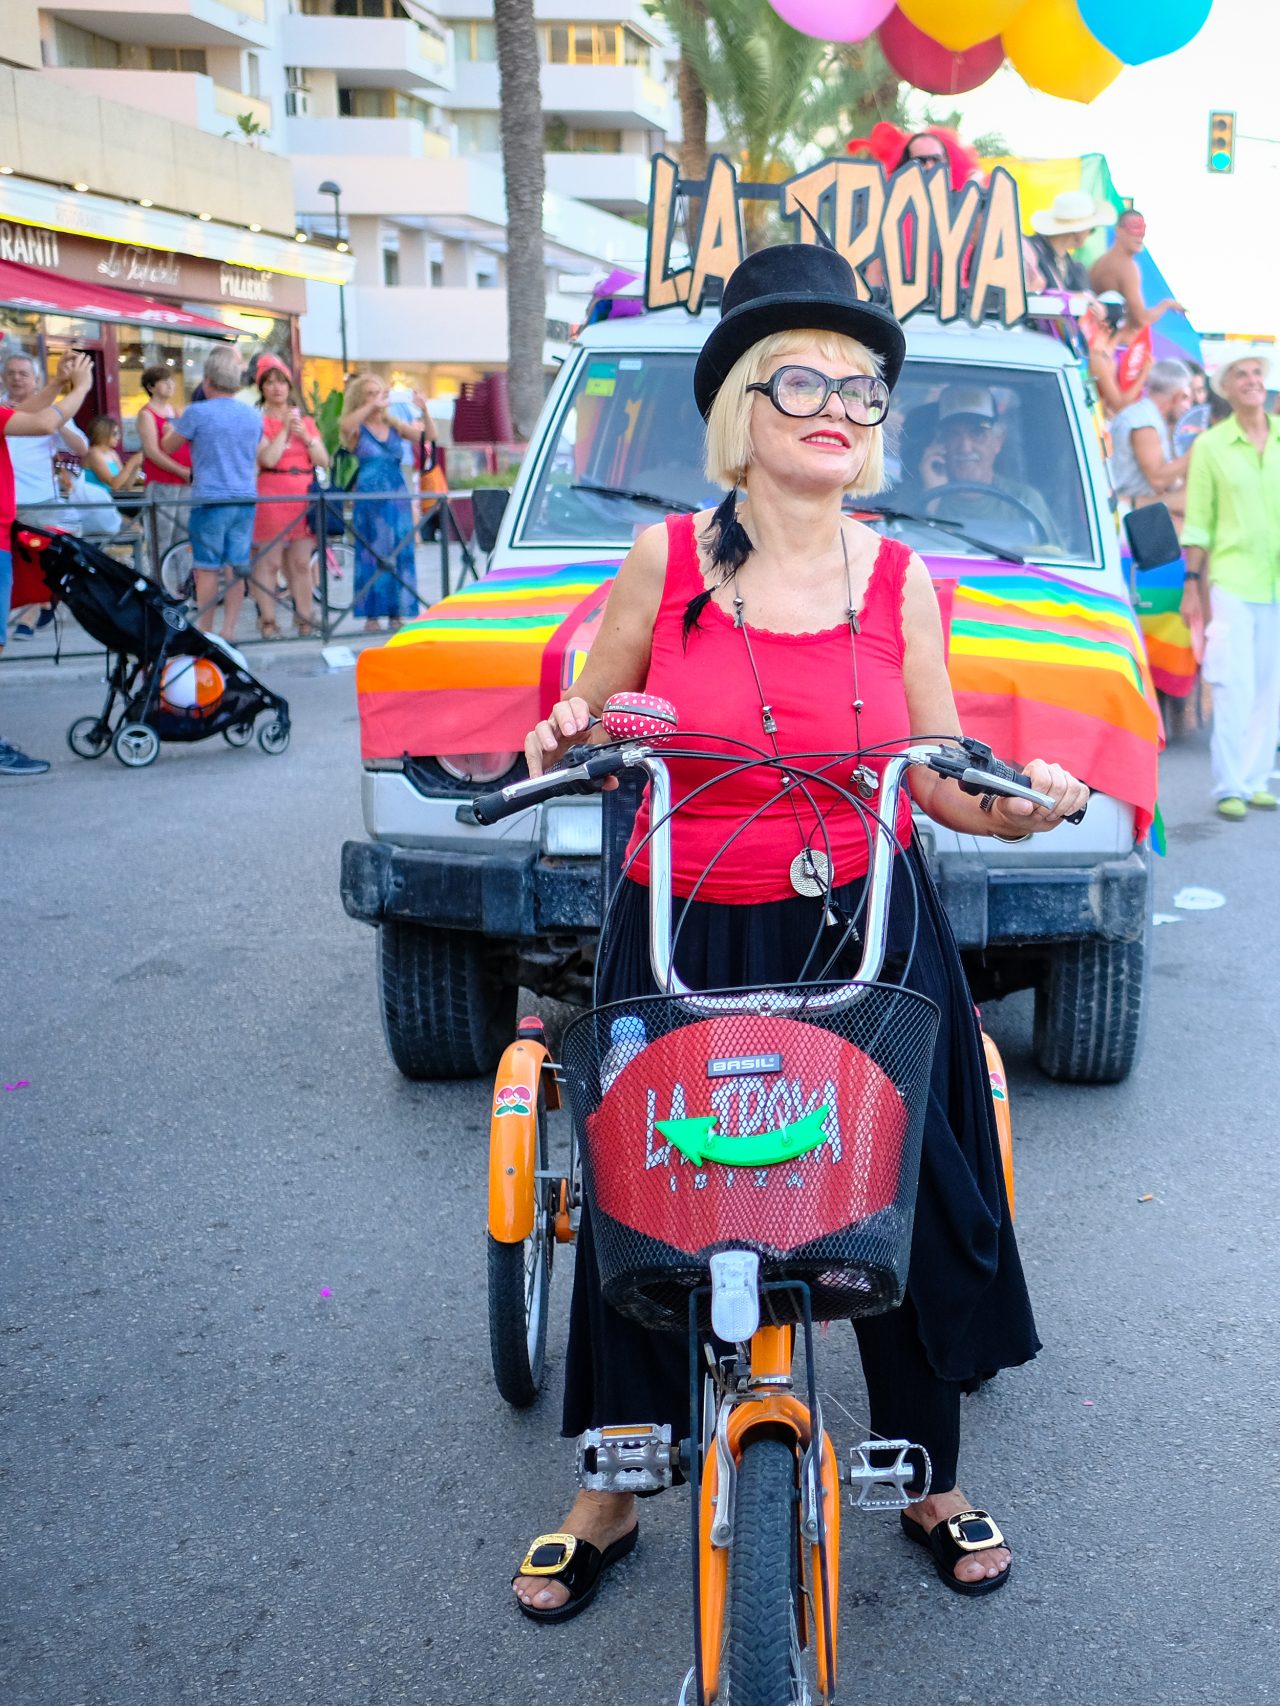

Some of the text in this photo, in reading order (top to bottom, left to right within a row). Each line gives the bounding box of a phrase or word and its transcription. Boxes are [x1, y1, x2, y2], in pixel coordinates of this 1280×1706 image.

[647, 153, 1028, 327] LA TROYA
[713, 1057, 774, 1072] BASIL
